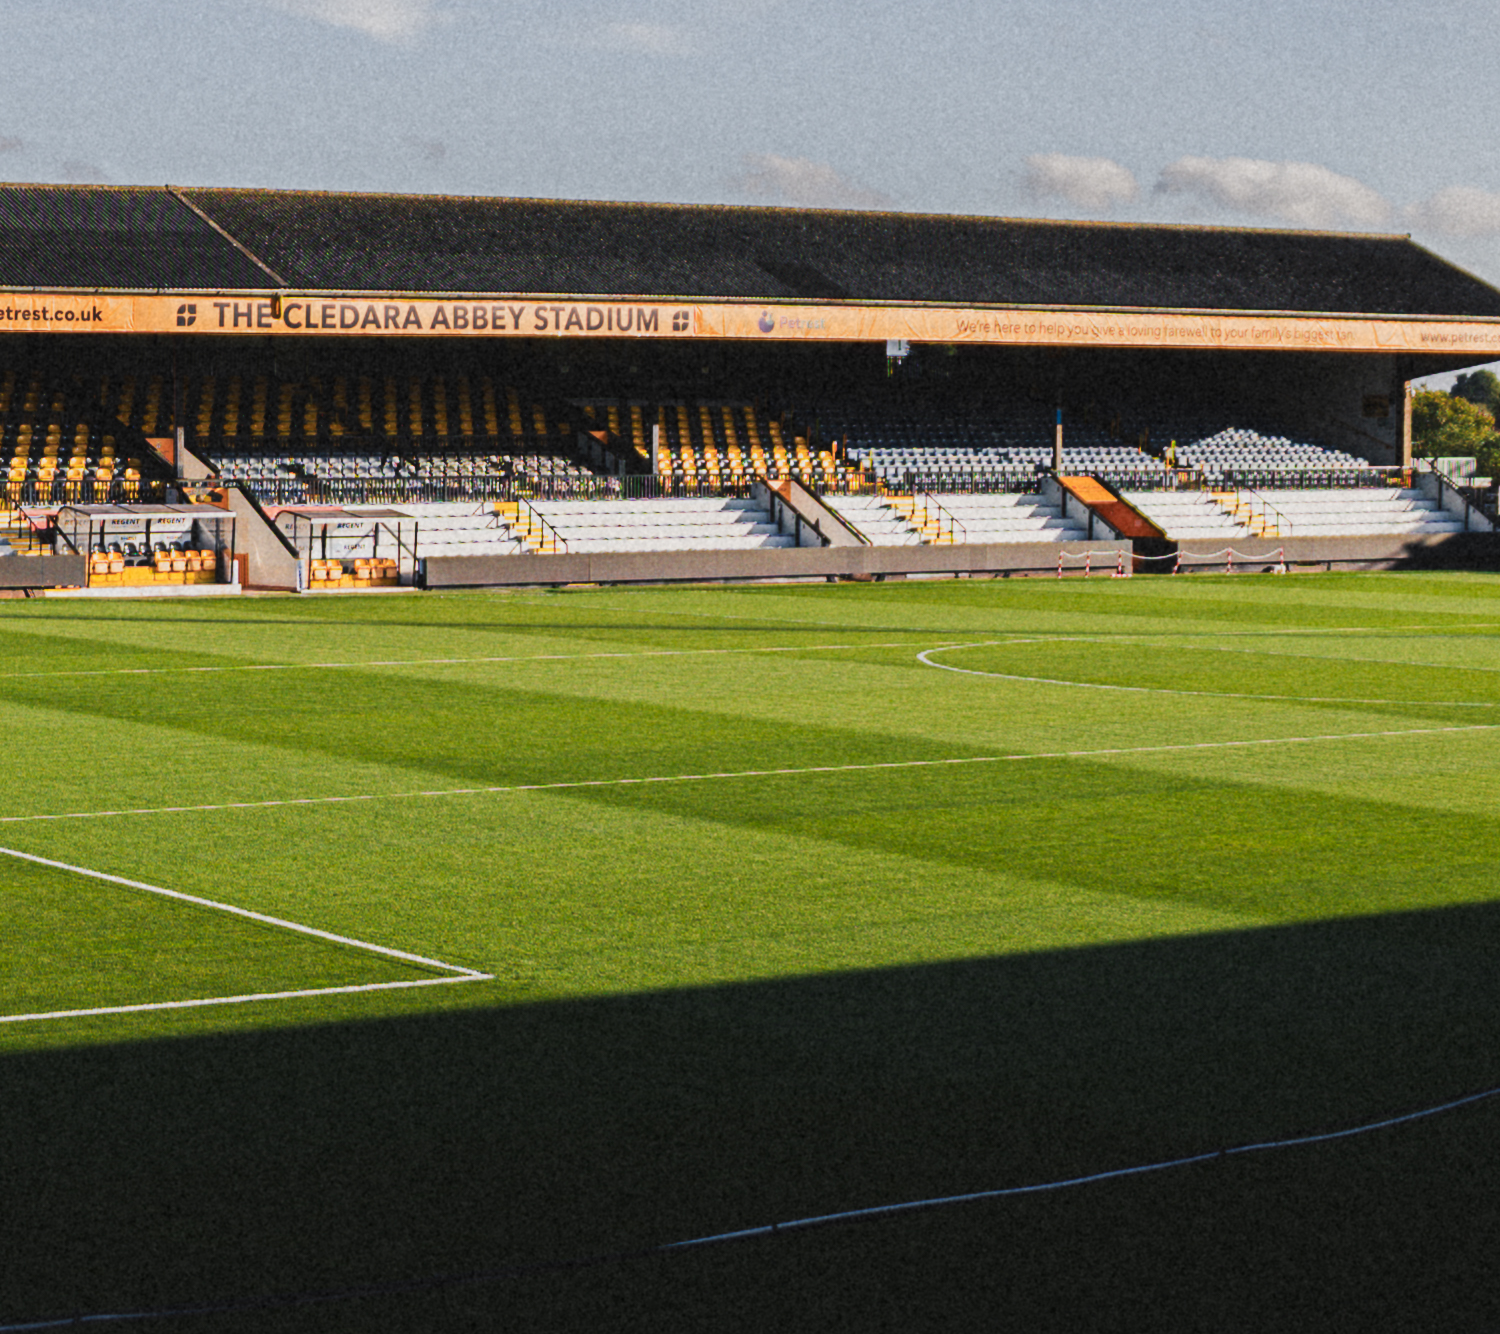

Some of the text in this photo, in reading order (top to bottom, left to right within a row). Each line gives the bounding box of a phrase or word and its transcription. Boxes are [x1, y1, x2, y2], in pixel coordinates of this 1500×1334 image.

[213, 302, 659, 332] THE CLEDARA ABBEY STADIUM
[956, 319, 990, 333] We're
[994, 320, 1021, 333] here
[1024, 321, 1036, 334] to
[1040, 321, 1064, 337] help
[1067, 324, 1088, 338] you
[1092, 324, 1115, 338] give
[1127, 324, 1161, 339] loving
[1163, 324, 1208, 339] farewell
[1210, 327, 1222, 338] to
[1225, 328, 1248, 342] your
[1251, 327, 1292, 343] family's
[1294, 328, 1333, 343] biggest
